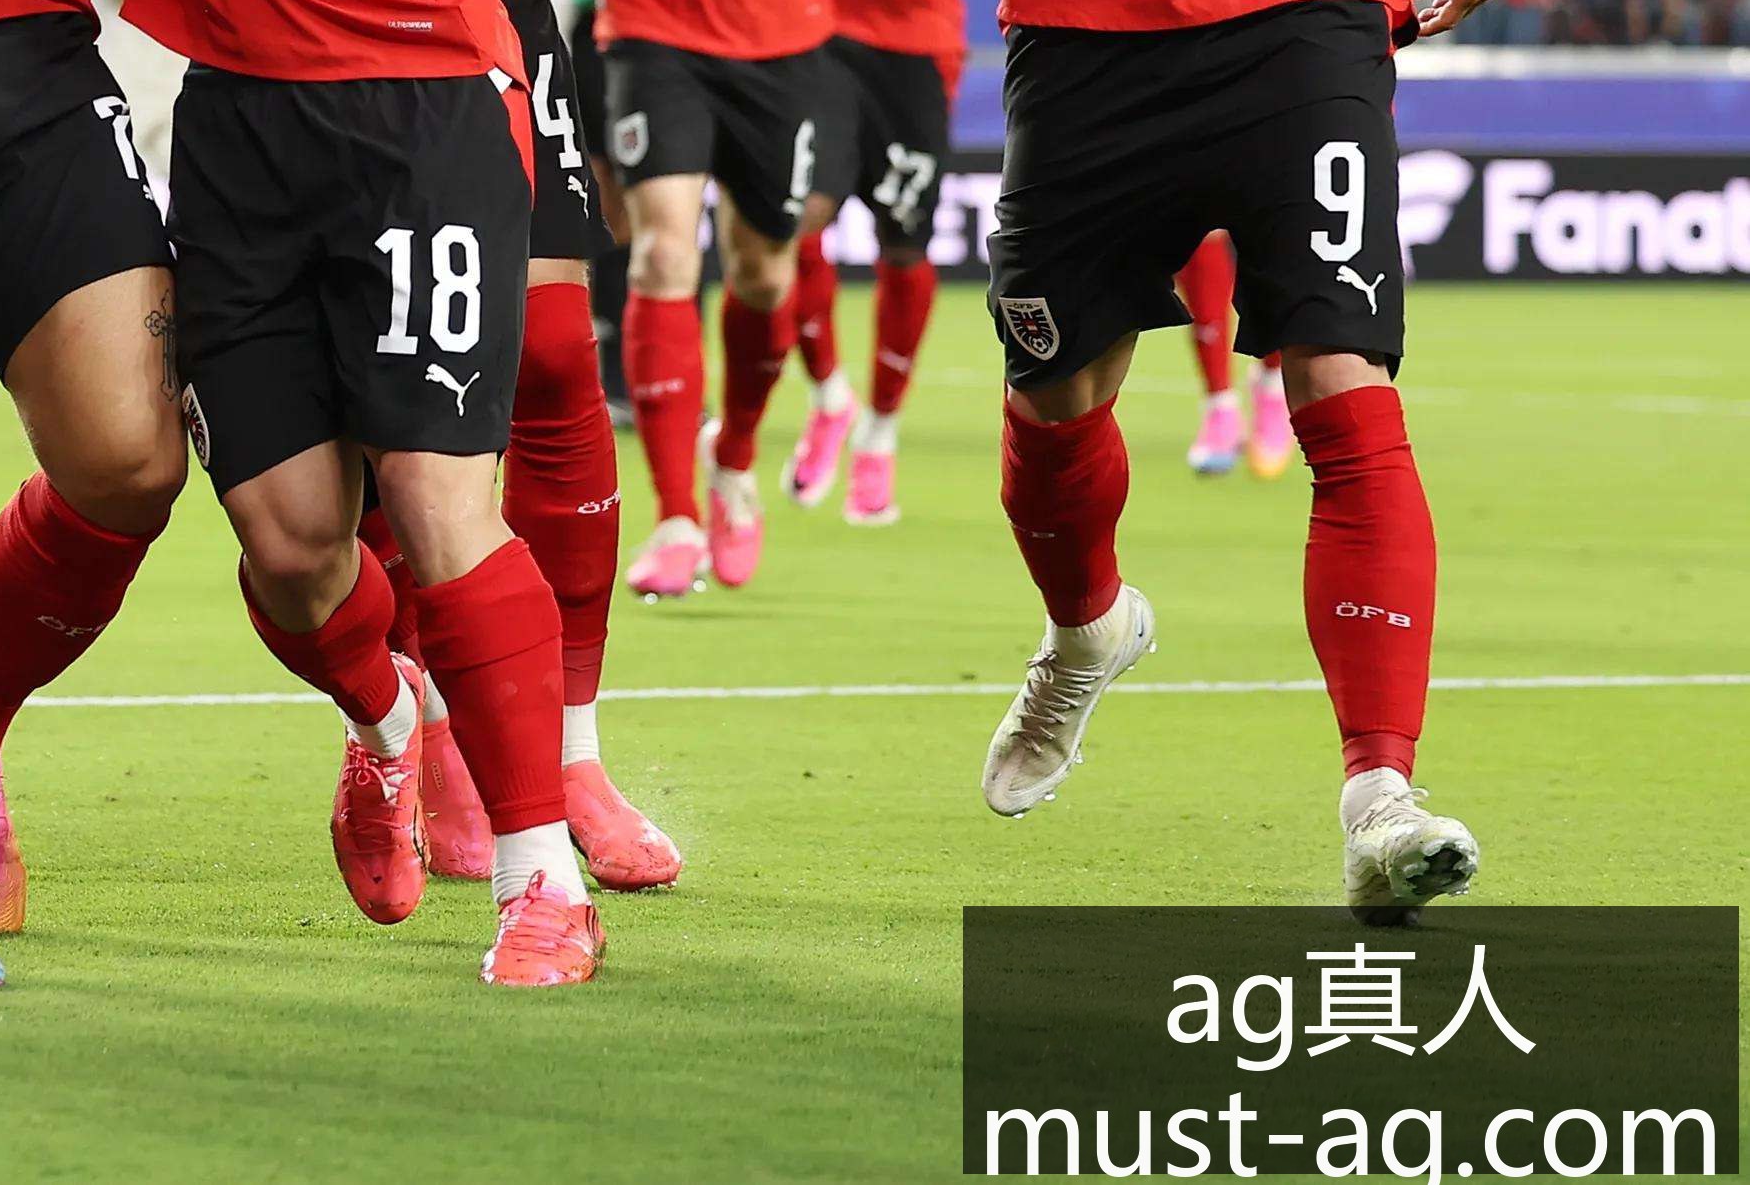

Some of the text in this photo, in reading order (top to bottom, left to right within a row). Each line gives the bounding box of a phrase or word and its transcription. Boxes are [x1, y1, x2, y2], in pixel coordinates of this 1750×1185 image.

[92, 95, 142, 181] 7
[532, 53, 584, 170] 4
[1310, 141, 1366, 262] 9
[374, 224, 482, 356] 18
[1334, 601, 1412, 628] ÖFB
